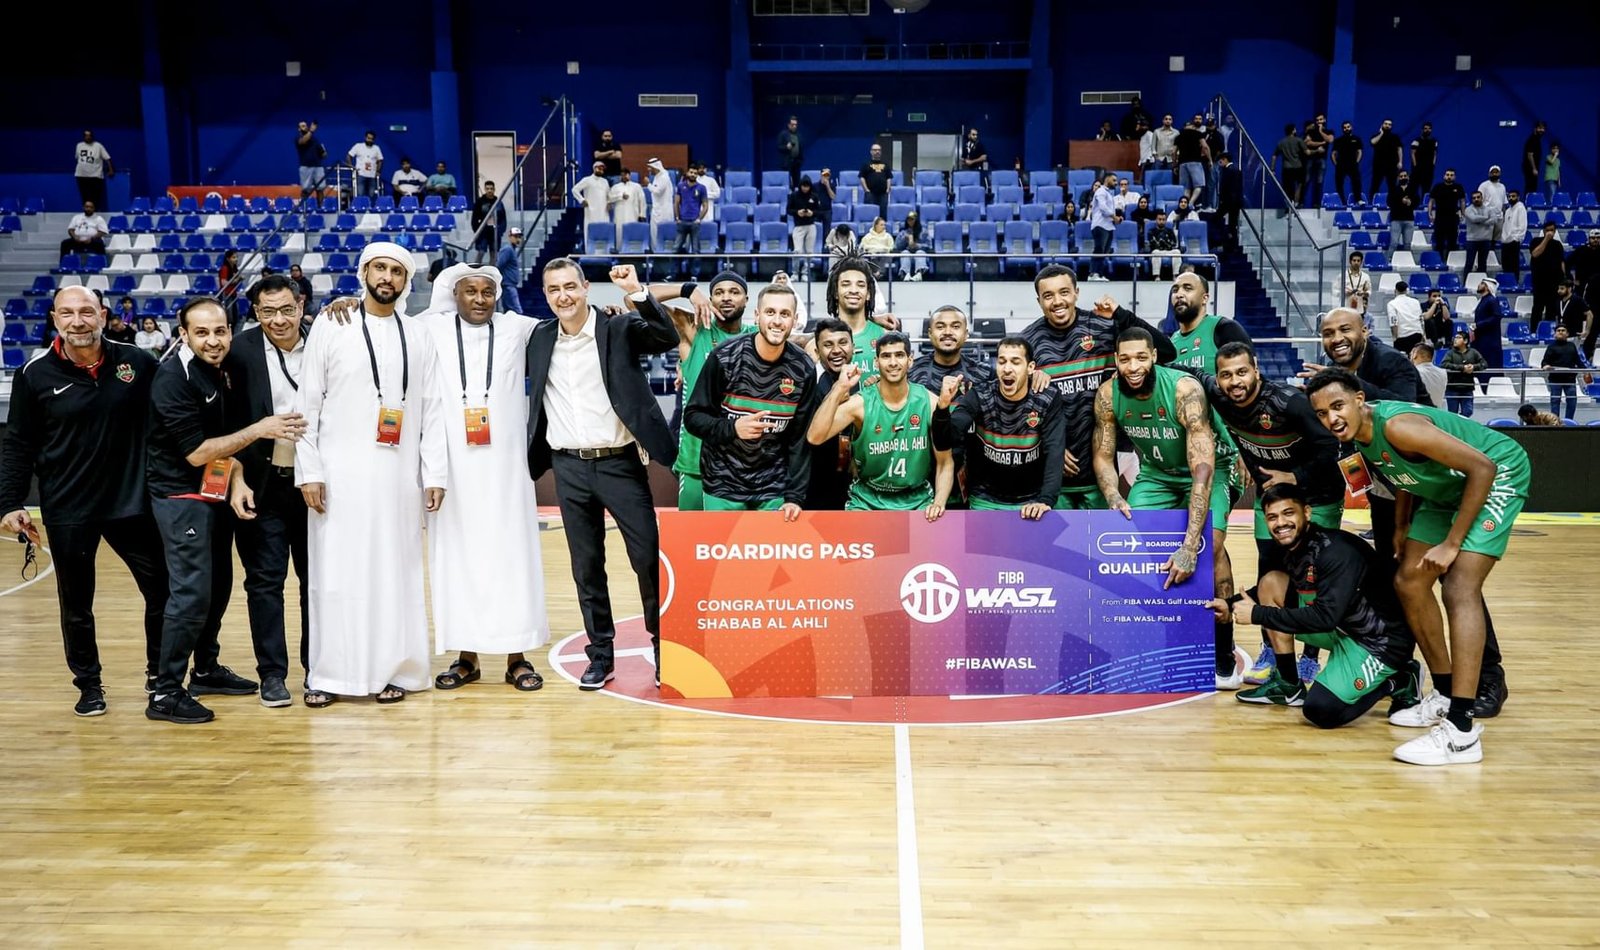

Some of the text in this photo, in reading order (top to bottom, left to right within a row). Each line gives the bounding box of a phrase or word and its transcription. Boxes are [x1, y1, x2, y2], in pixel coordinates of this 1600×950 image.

[869, 435, 928, 455] SHABAB AL AHLI
[983, 445, 1040, 466] SHABAB AL AHLI
[1152, 445, 1164, 462] 4
[1271, 447, 1291, 460] AHLI
[888, 457, 907, 478] 14
[695, 543, 876, 560] BOARDING PASS
[1098, 562, 1170, 575] QUALIFI
[998, 571, 1025, 585] FIBA
[696, 598, 855, 612] CONGRATULATIONS
[964, 587, 1058, 608] WASL
[696, 616, 829, 631] SHABAB AL AHLI
[945, 657, 1037, 670] #FIBAWASL
